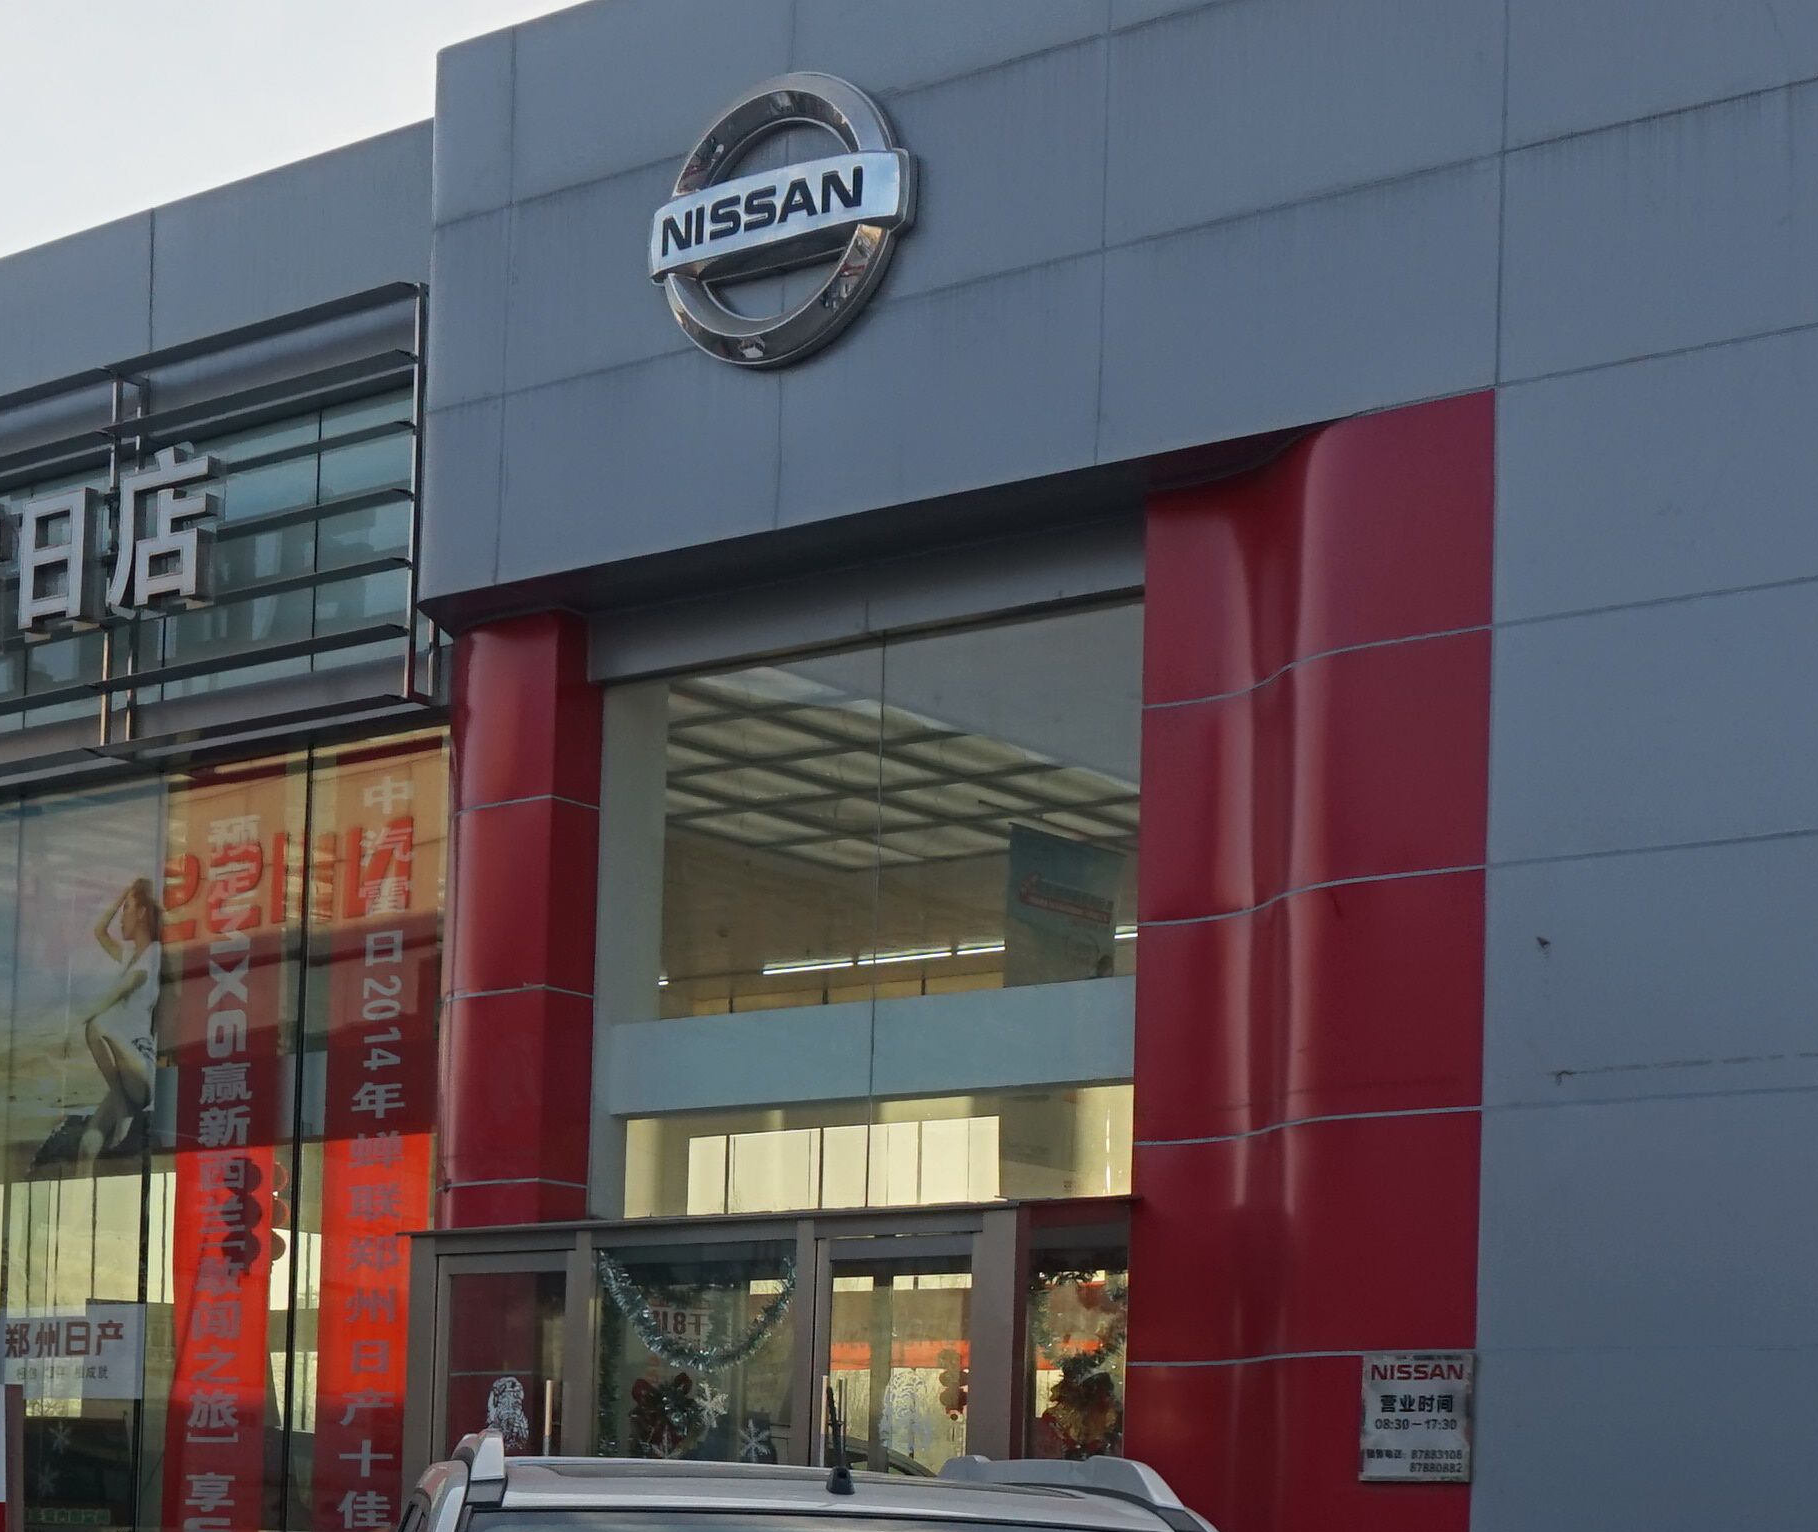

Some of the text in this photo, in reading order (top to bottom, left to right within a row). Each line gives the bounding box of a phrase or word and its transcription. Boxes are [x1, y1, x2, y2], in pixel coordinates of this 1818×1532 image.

[661, 166, 864, 258] NISSAN
[5, 1320, 124, 1358] 郑州日产
[1371, 1364, 1464, 1380] NISSAN
[1380, 1394, 1453, 1413] 营业时间
